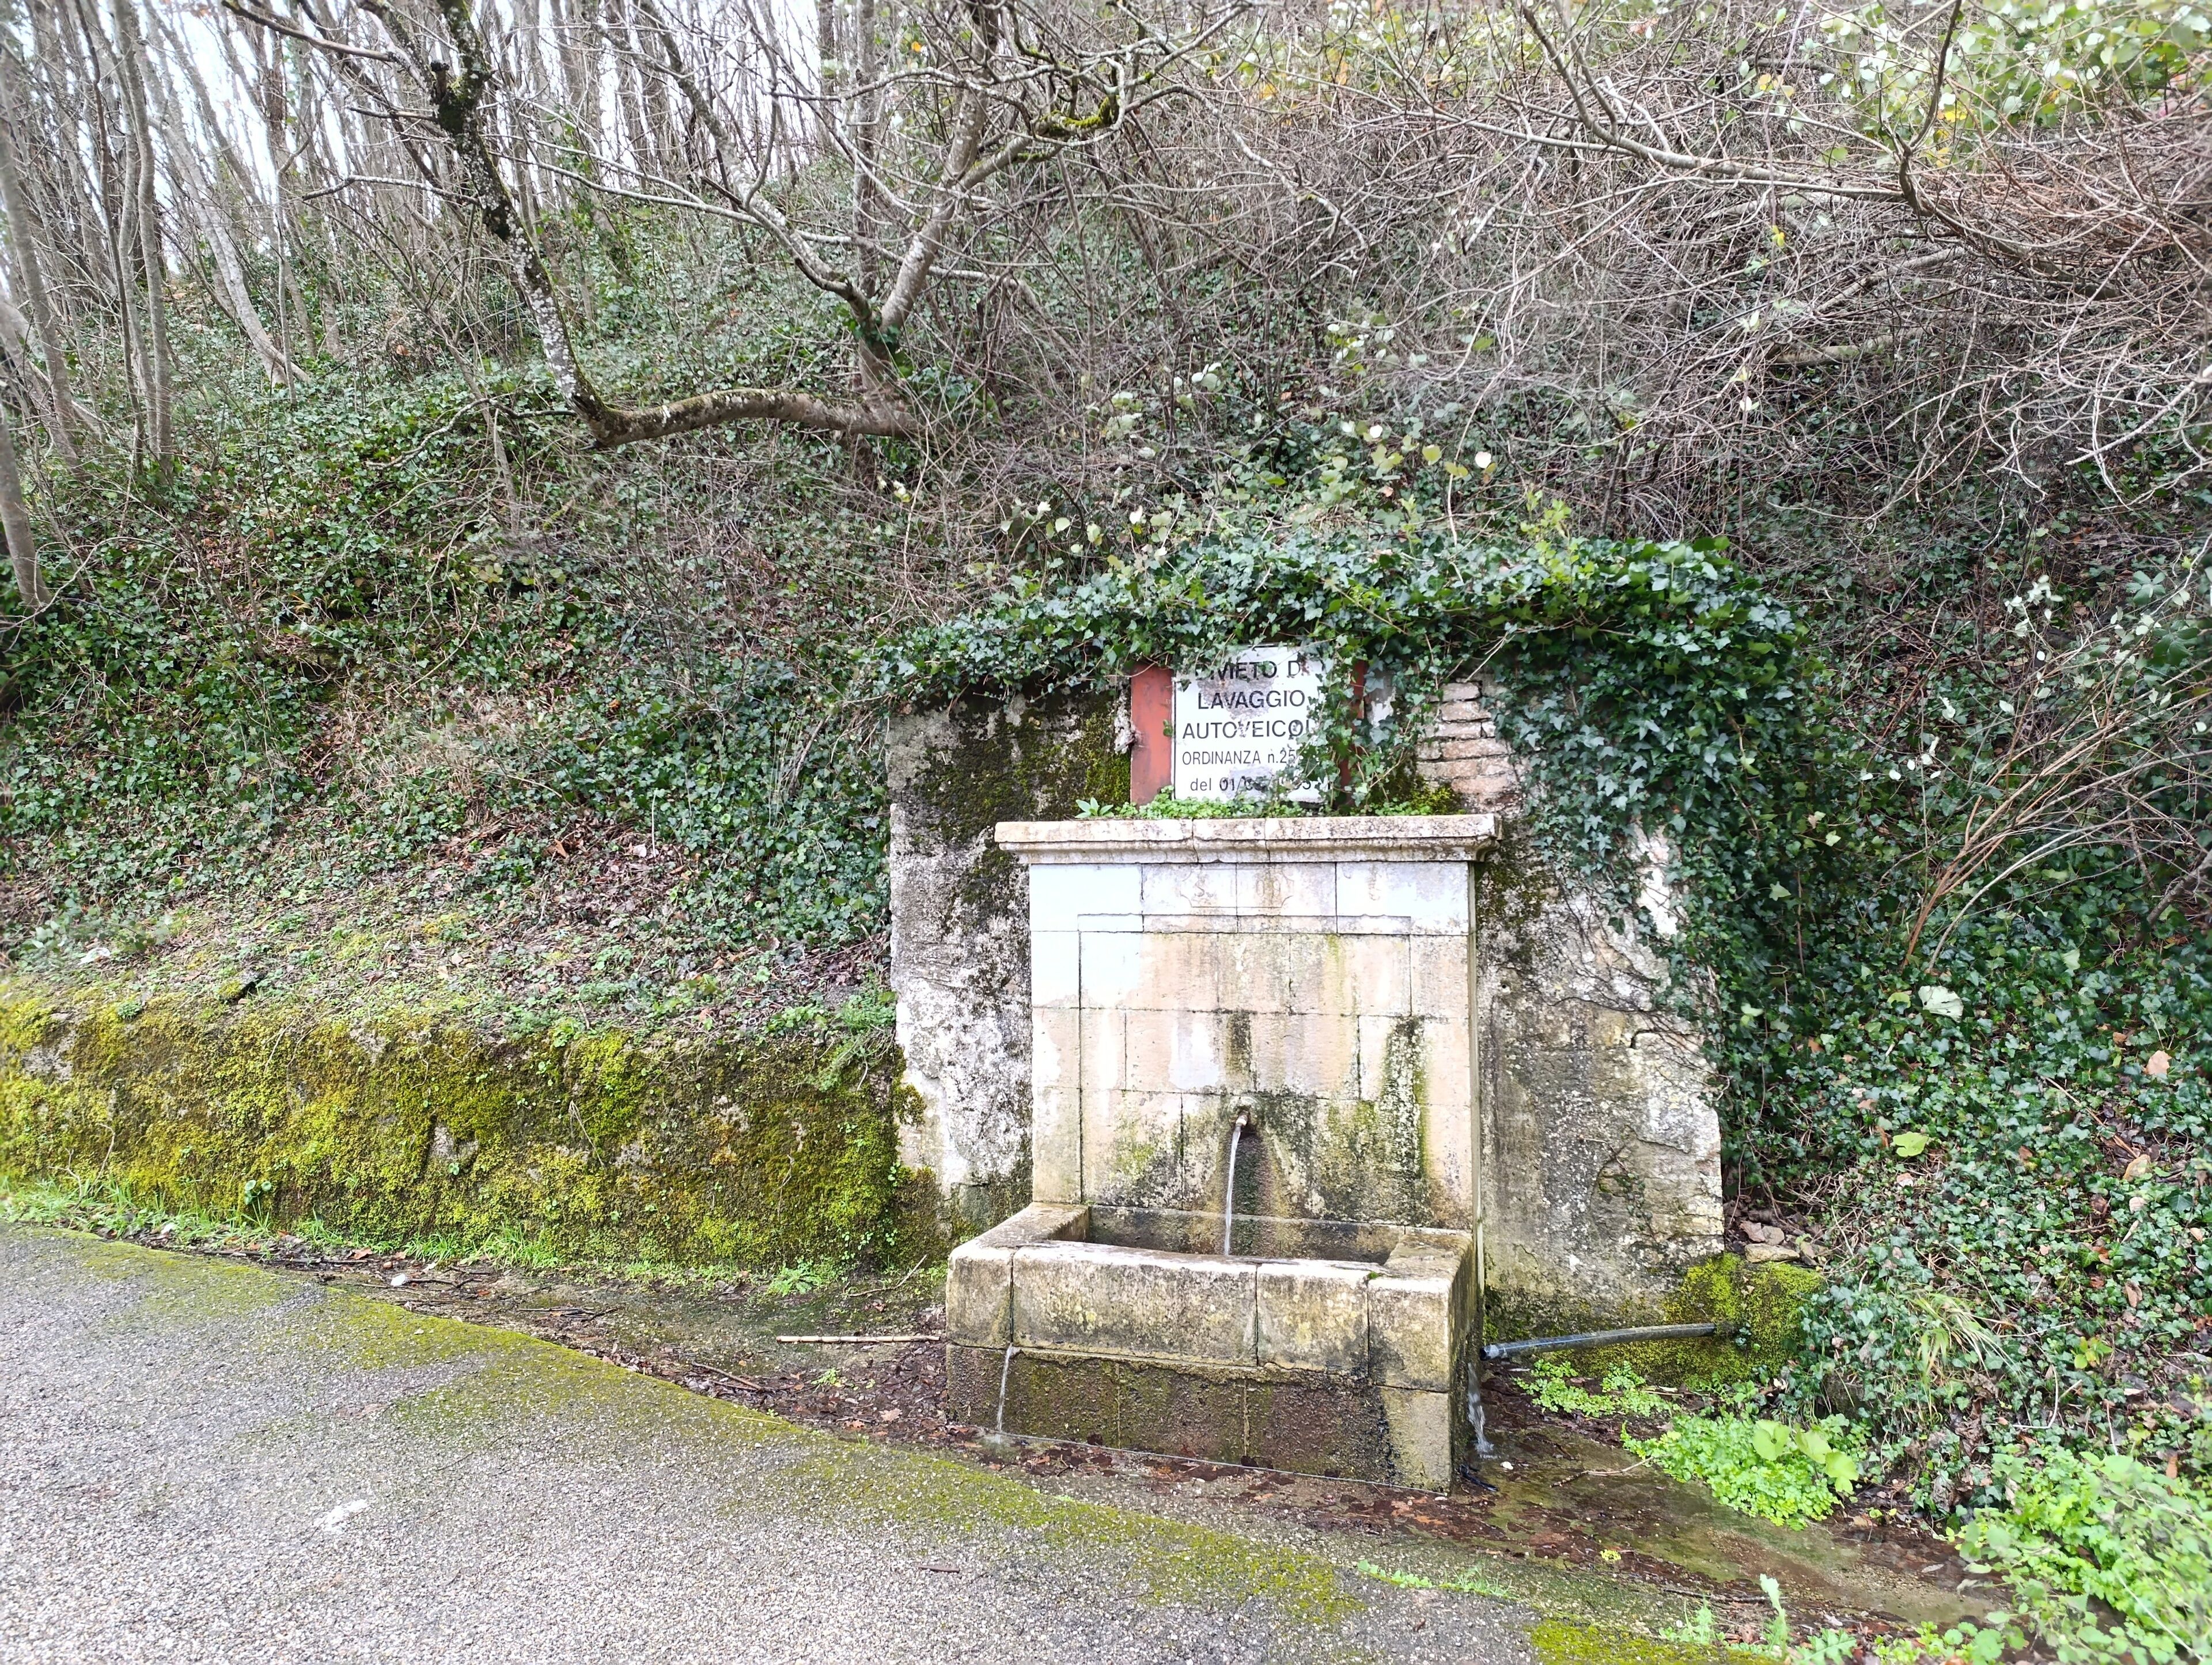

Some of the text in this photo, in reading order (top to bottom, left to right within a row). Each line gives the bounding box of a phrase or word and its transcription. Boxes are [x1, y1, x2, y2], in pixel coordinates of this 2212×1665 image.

[1198, 690, 1305, 710] LAVAGGIO
[1182, 750, 1261, 765] ORDINANZA
[1190, 777, 1211, 791] del
